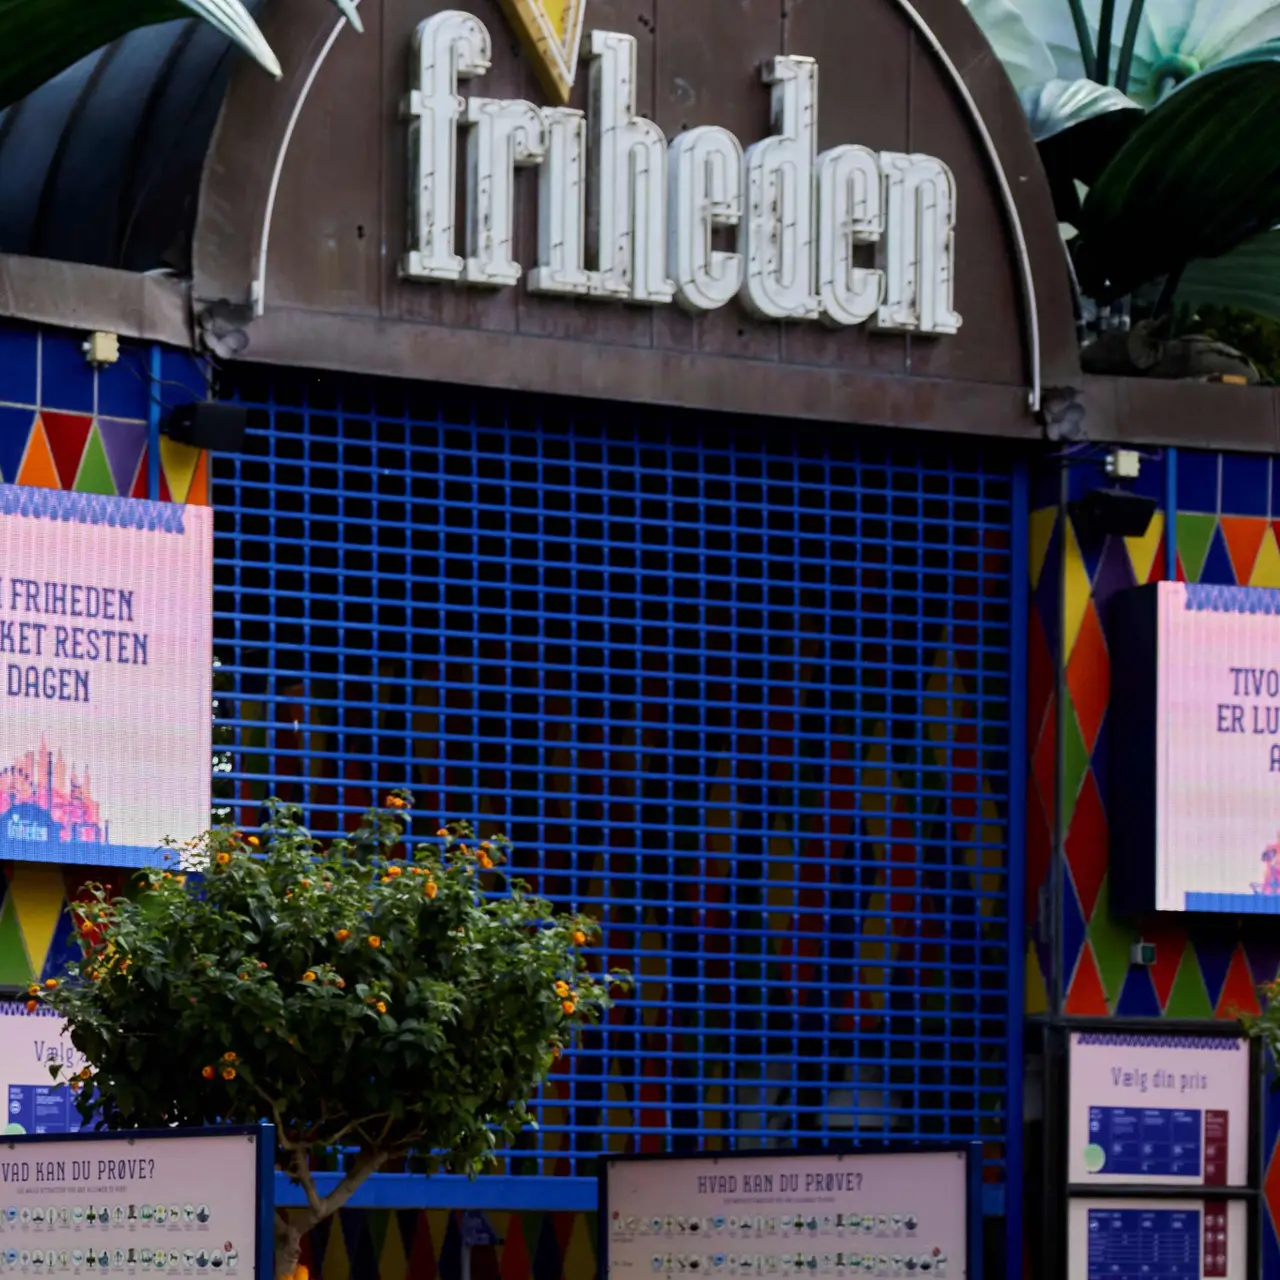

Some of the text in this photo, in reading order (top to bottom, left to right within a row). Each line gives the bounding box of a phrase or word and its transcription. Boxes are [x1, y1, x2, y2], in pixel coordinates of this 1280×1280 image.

[397, 9, 963, 335] friheden
[10, 577, 134, 622] FRIHEDEN
[54, 625, 148, 666] RESTEN
[7, 663, 90, 702] DAGEN
[1216, 703, 1246, 734] ER
[33, 1040, 75, 1069] Vælg
[1110, 1066, 1209, 1094] Vælg din pris
[36, 1161, 67, 1182] KAN
[71, 1160, 92, 1181] DU
[97, 1159, 156, 1180] PRØVE?
[696, 1172, 864, 1194] HVAD KAN DU PRØVE?
